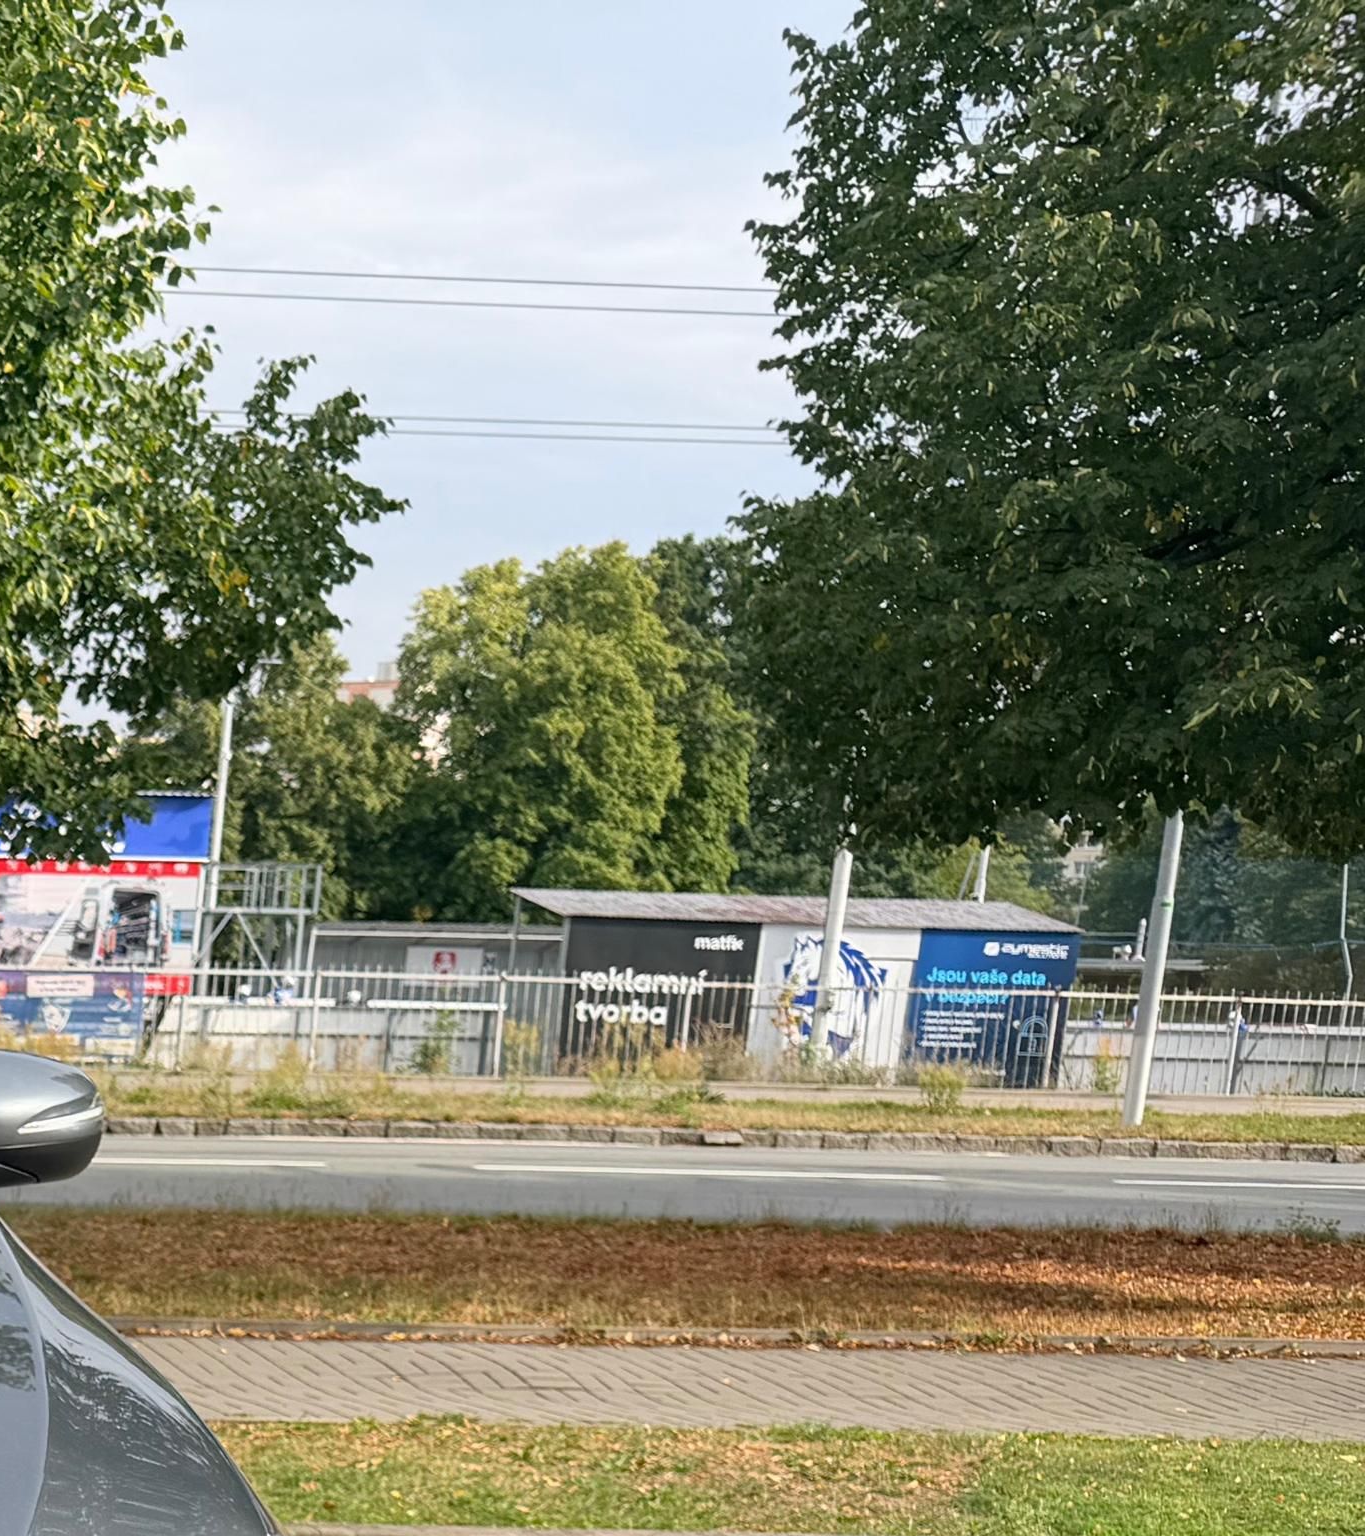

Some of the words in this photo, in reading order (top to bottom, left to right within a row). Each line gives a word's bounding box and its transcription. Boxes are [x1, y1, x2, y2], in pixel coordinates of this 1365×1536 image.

[579, 966, 708, 995] reklamní
[926, 966, 967, 983] Jsou
[970, 968, 1008, 985] vaše
[1011, 969, 1046, 986] data
[575, 999, 668, 1025] tvorba
